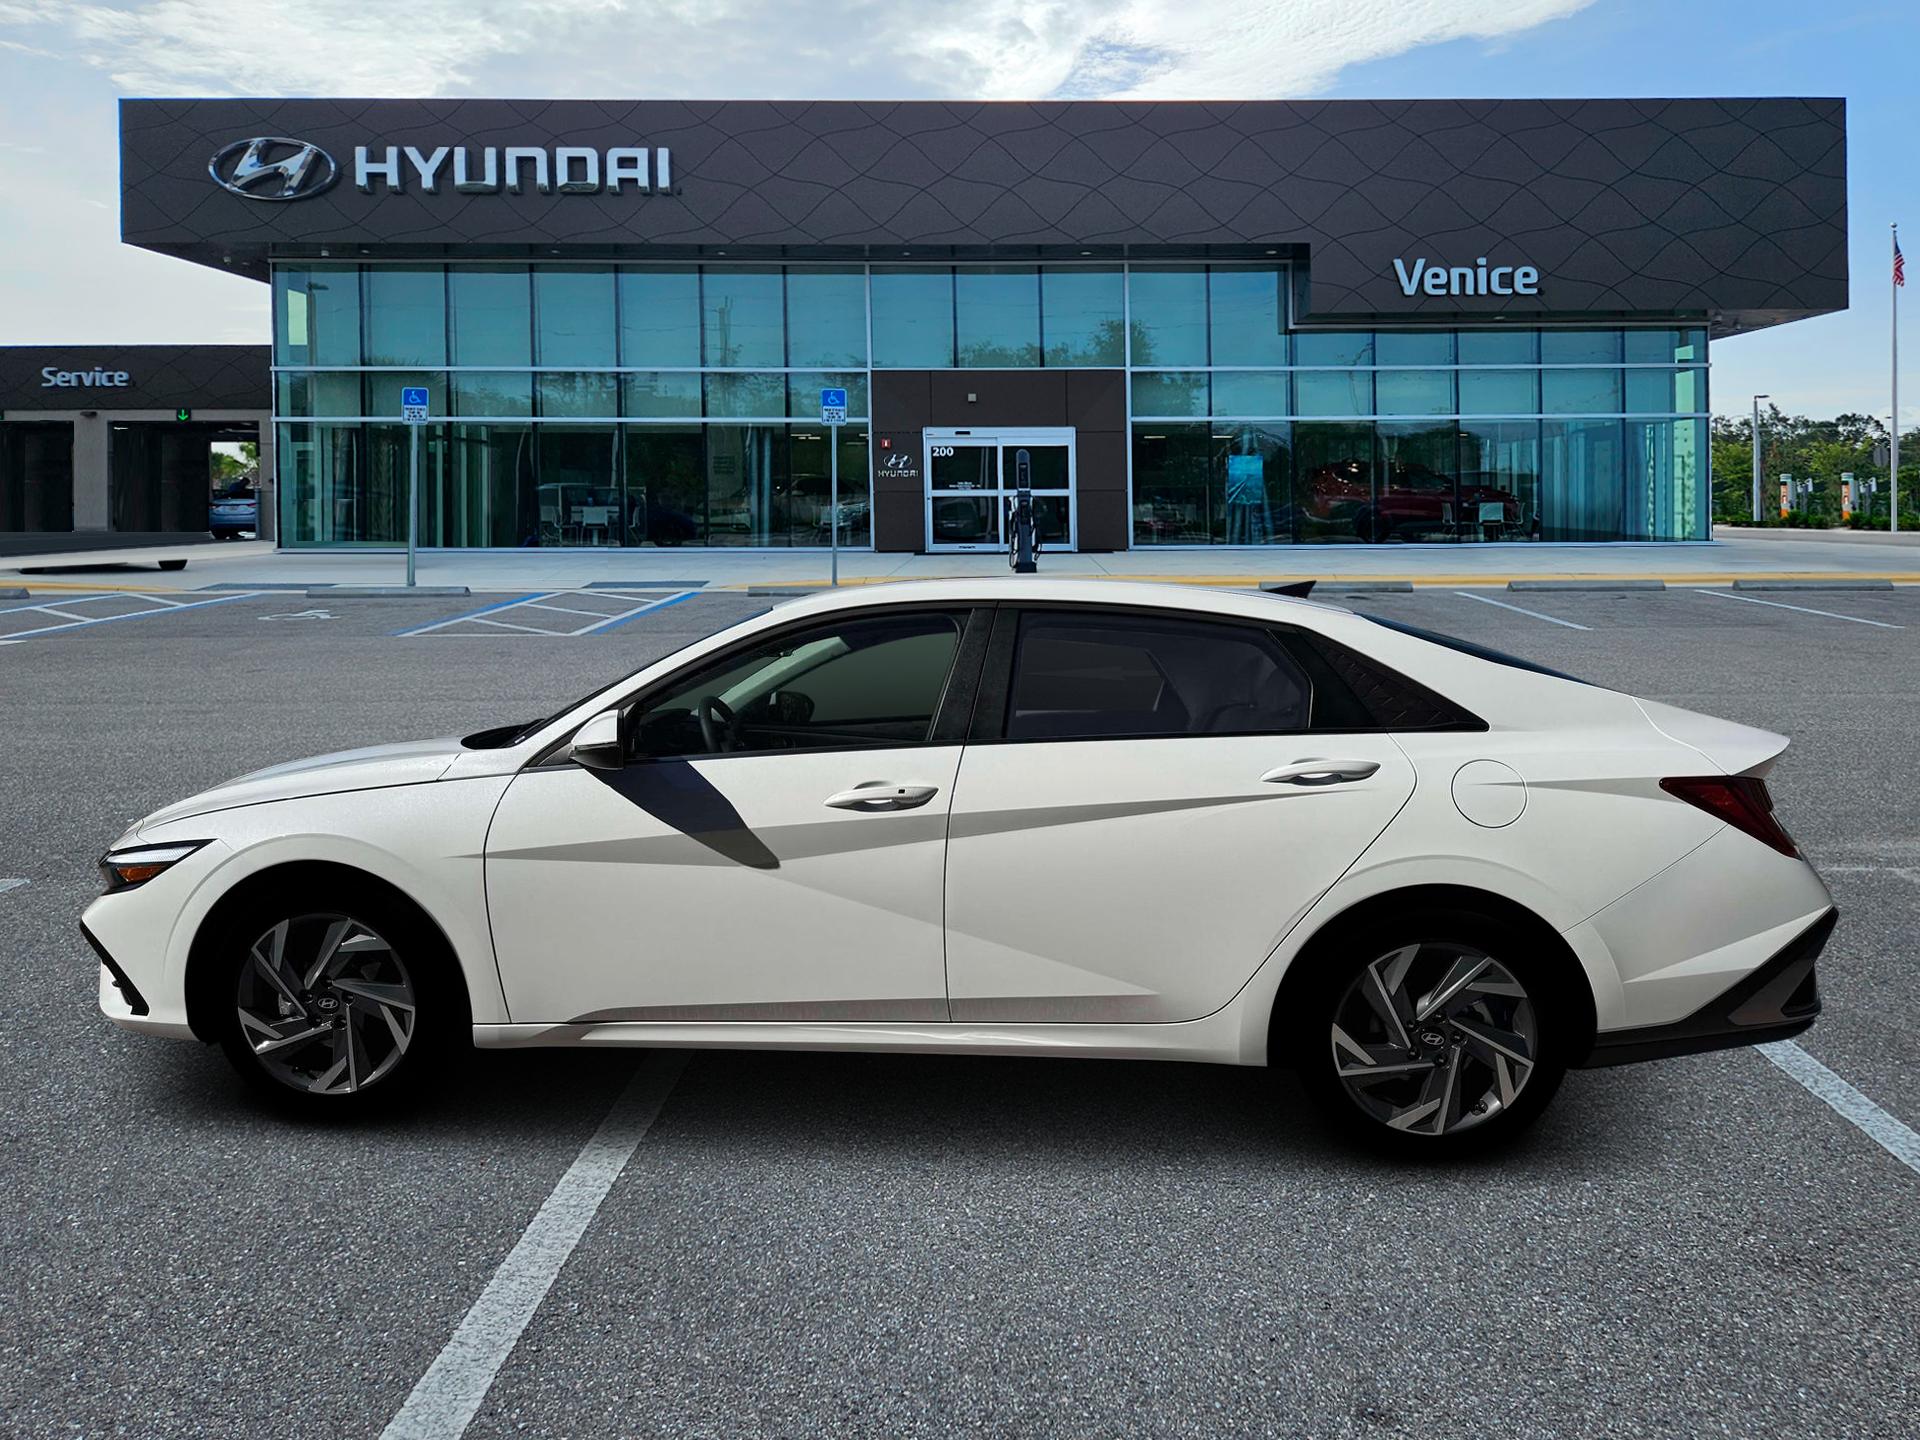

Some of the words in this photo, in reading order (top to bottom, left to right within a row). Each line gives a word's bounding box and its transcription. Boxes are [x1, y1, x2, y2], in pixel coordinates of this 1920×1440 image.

[354, 146, 669, 194] HYUNDAI
[1392, 256, 1539, 296] Venice
[41, 366, 130, 387] Service
[932, 446, 955, 457] 200
[877, 469, 919, 478] HYUNDAI
